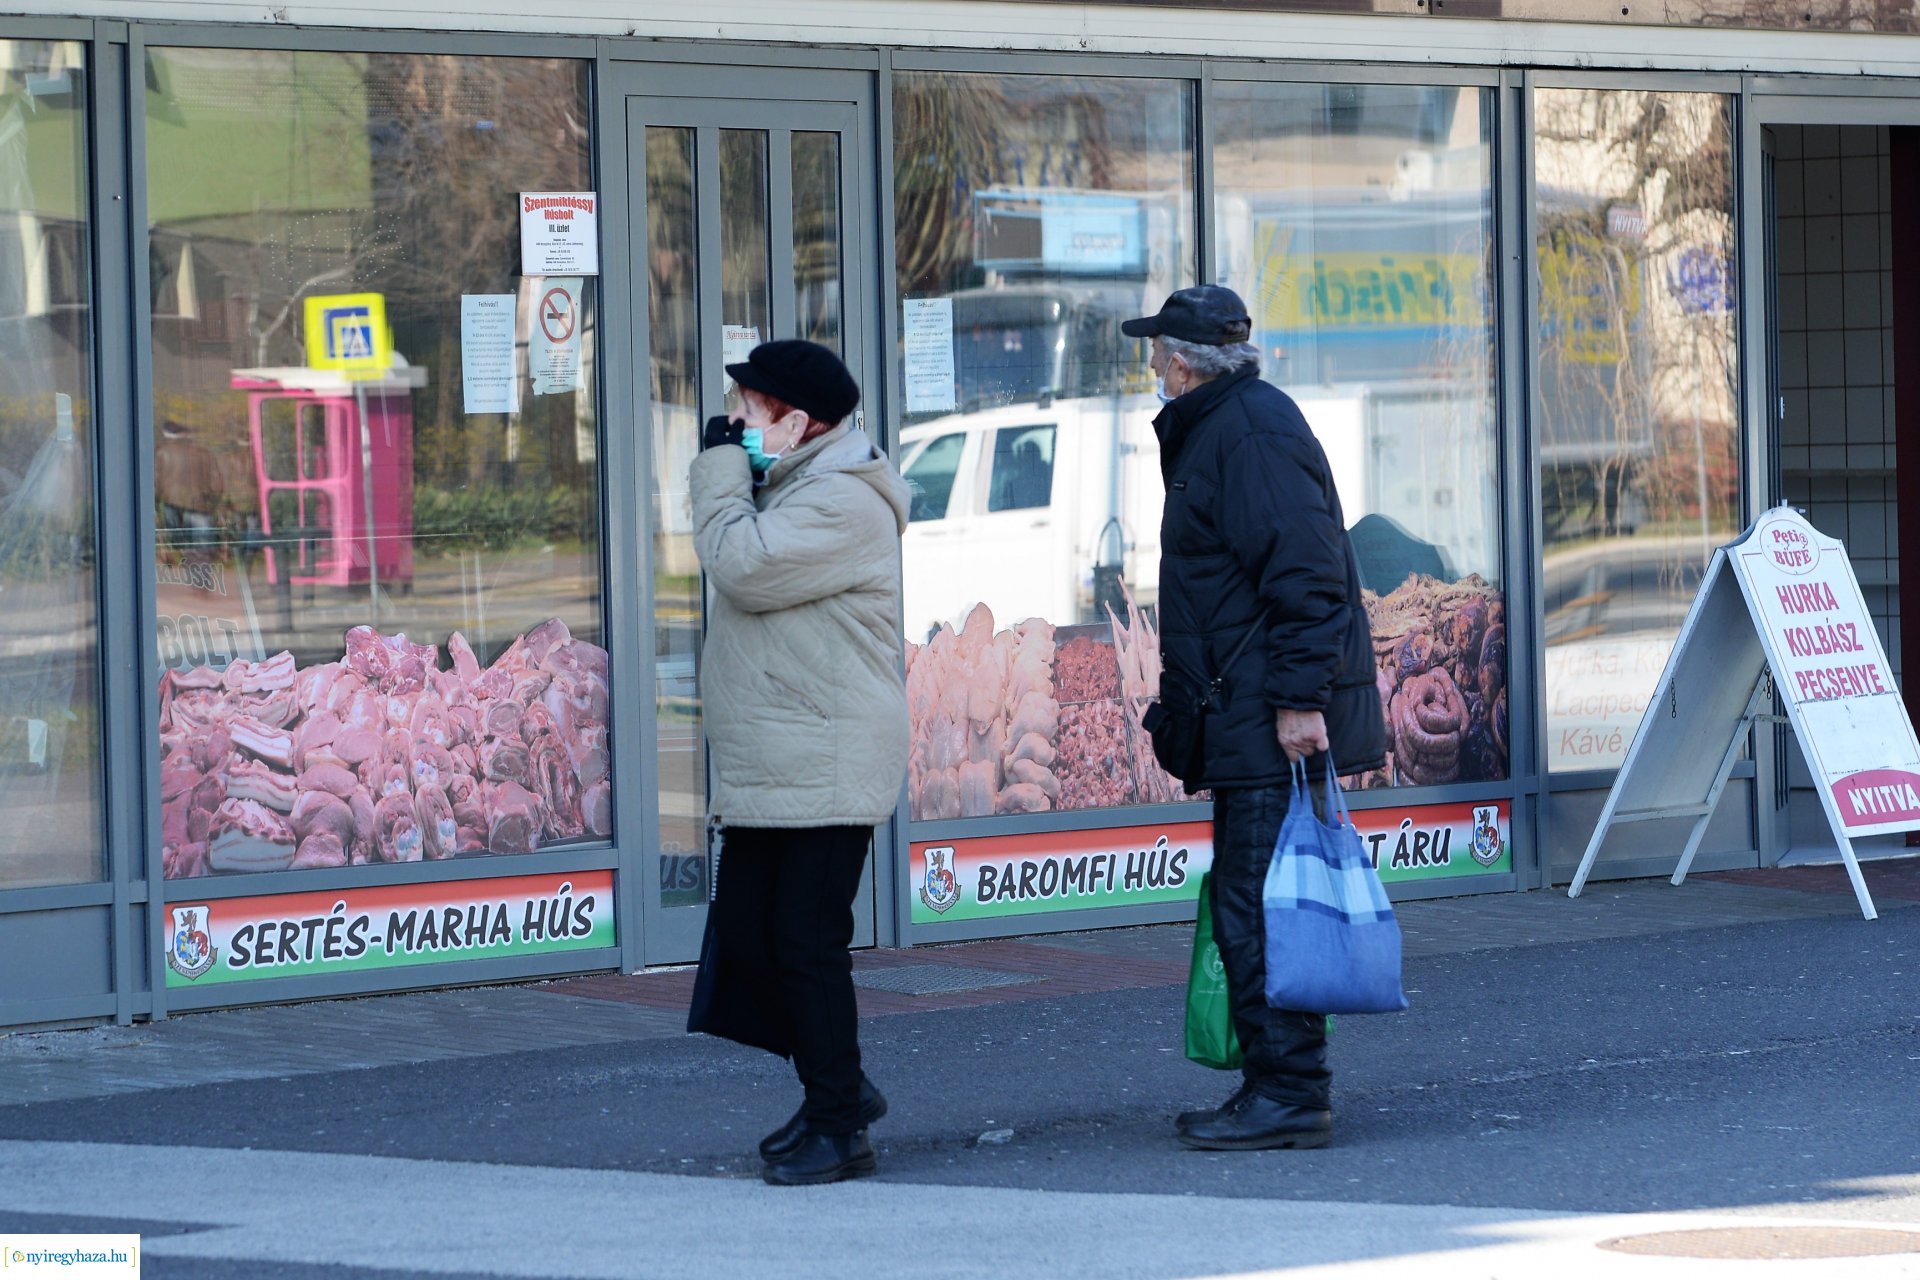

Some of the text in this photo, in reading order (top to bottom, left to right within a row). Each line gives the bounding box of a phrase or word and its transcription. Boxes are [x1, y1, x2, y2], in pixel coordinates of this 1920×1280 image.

[1772, 529, 1799, 543] Peti
[1776, 582, 1839, 614] HURKA
[1783, 617, 1864, 657] KOLBÁSZ
[1795, 664, 1884, 699] PECSENYE
[1847, 783, 1920, 816] NYITVA
[1391, 819, 1452, 868] ÁRU
[976, 837, 1188, 902] BAROMFI HÚS
[228, 882, 595, 967] SERTÉS-MARHA HÚS
